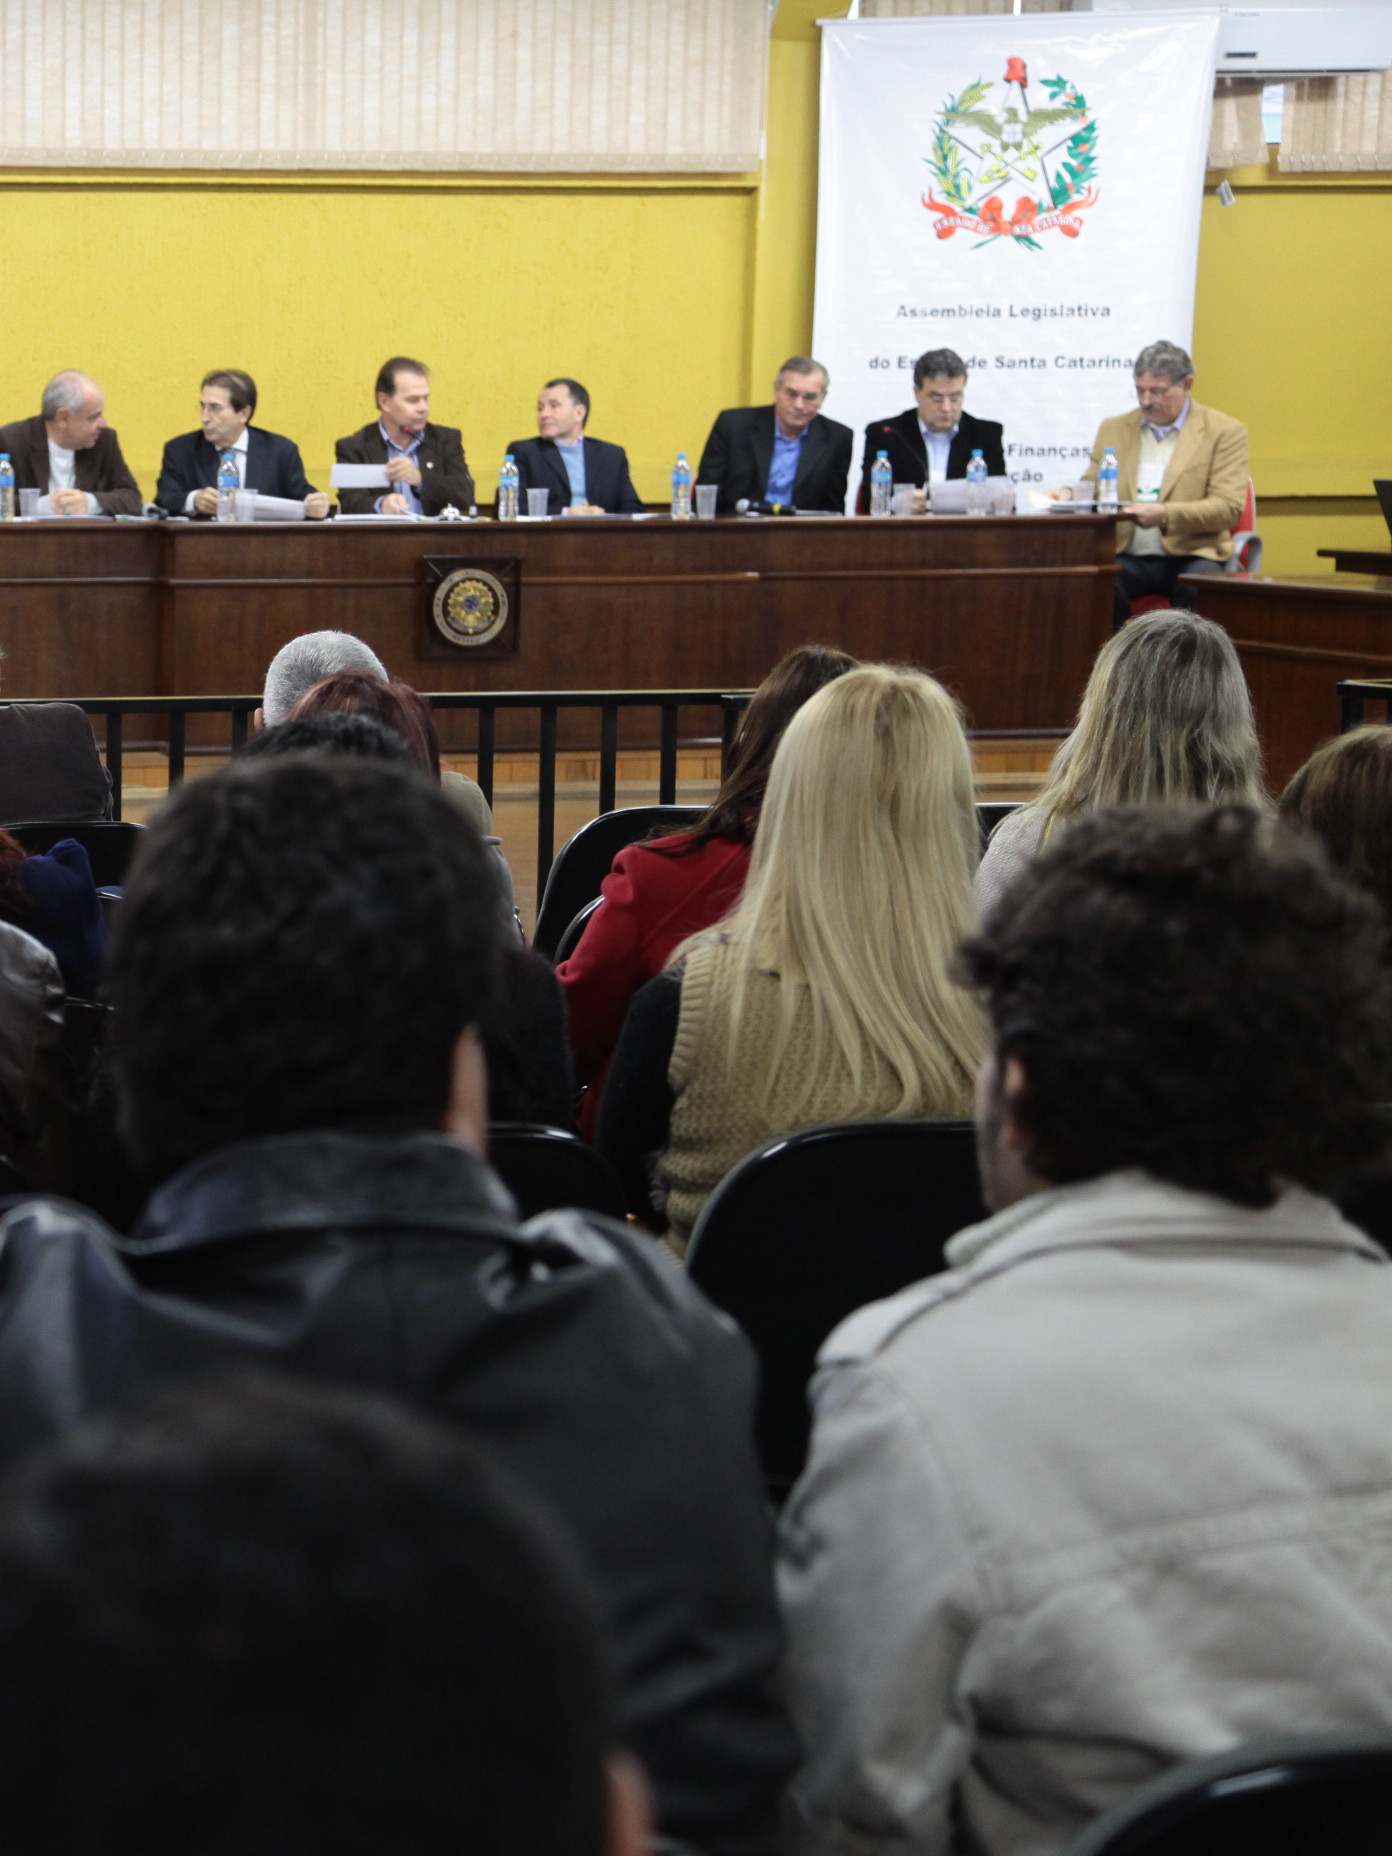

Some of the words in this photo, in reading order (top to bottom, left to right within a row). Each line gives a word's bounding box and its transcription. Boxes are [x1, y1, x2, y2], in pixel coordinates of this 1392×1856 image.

[896, 304, 1002, 318] Assembleia
[1009, 304, 1110, 321] Legislativa
[869, 355, 890, 369] do
[966, 355, 988, 369] de
[995, 355, 1047, 370] Santa
[1054, 355, 1133, 369] Catarina
[1008, 443, 1090, 460] Finanças
